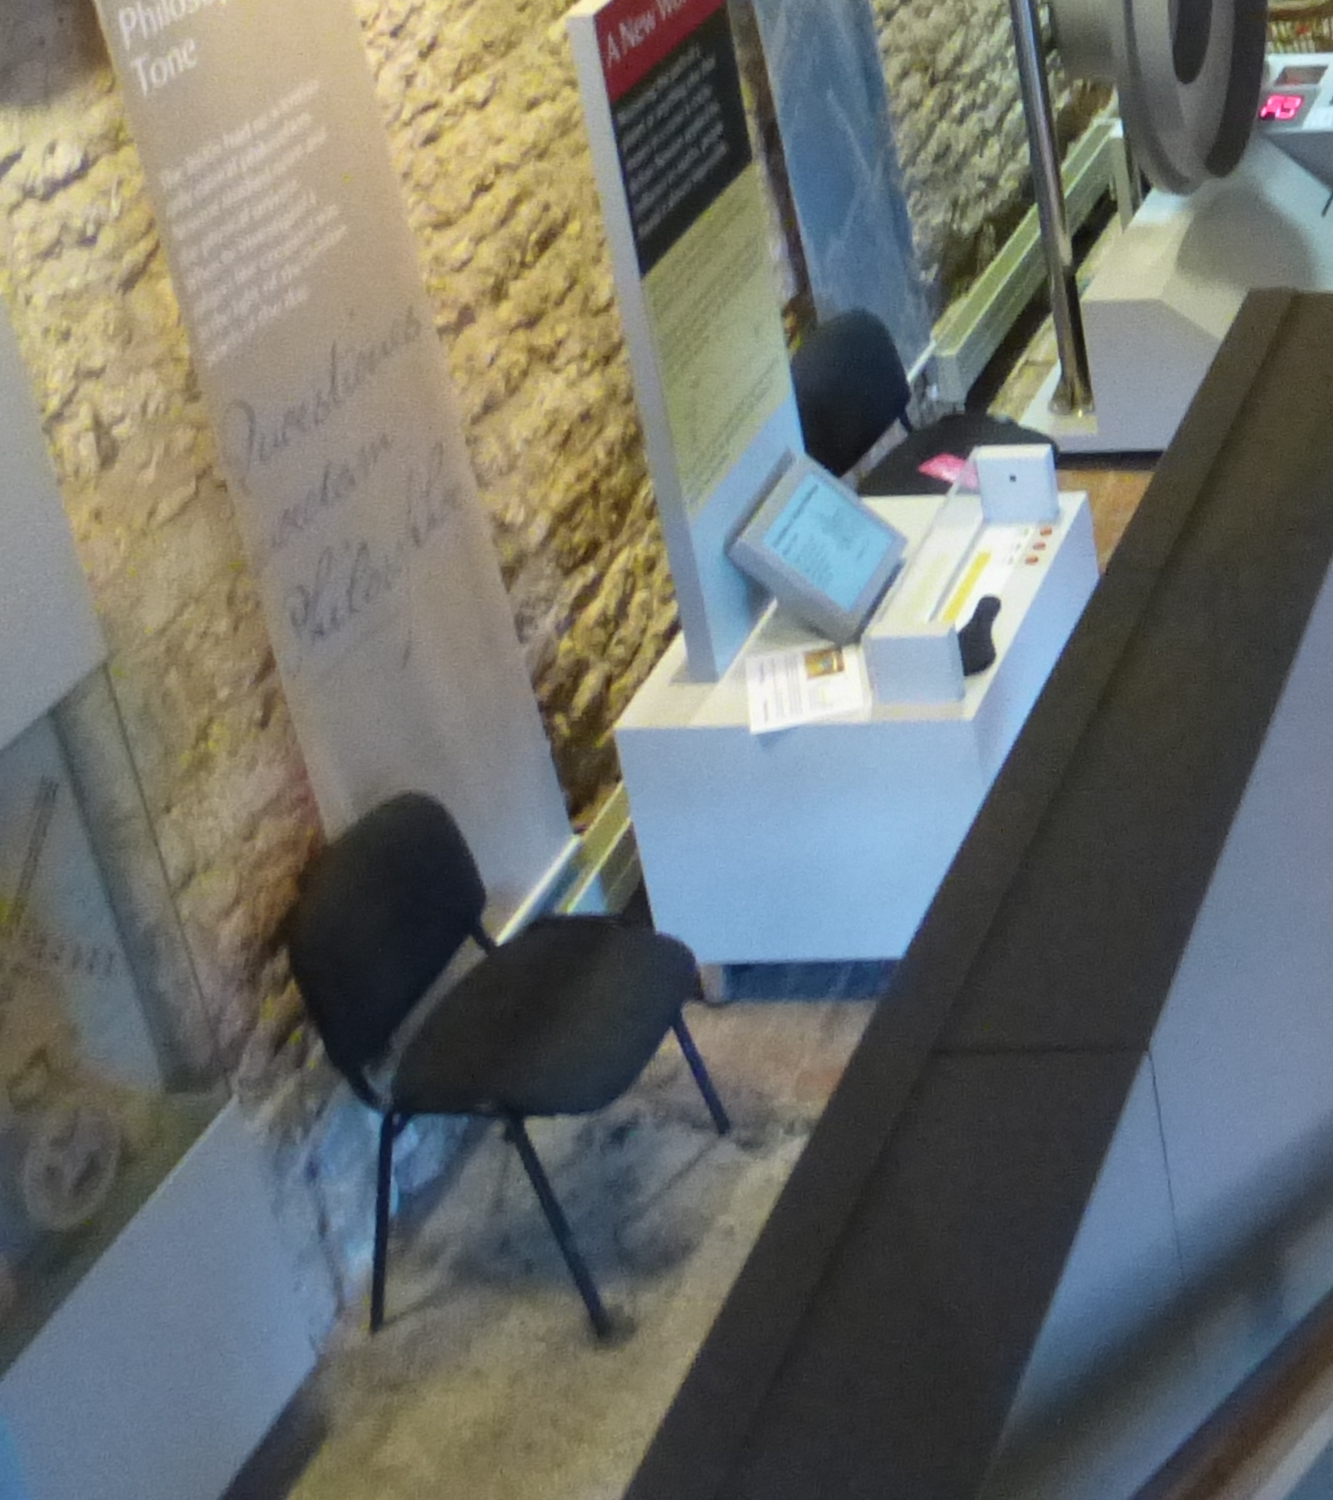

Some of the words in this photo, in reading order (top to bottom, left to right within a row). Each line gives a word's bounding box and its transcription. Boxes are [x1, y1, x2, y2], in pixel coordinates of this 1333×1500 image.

[606, 31, 621, 69] A
[622, 0, 658, 52] New
[132, 37, 199, 98] Tone
